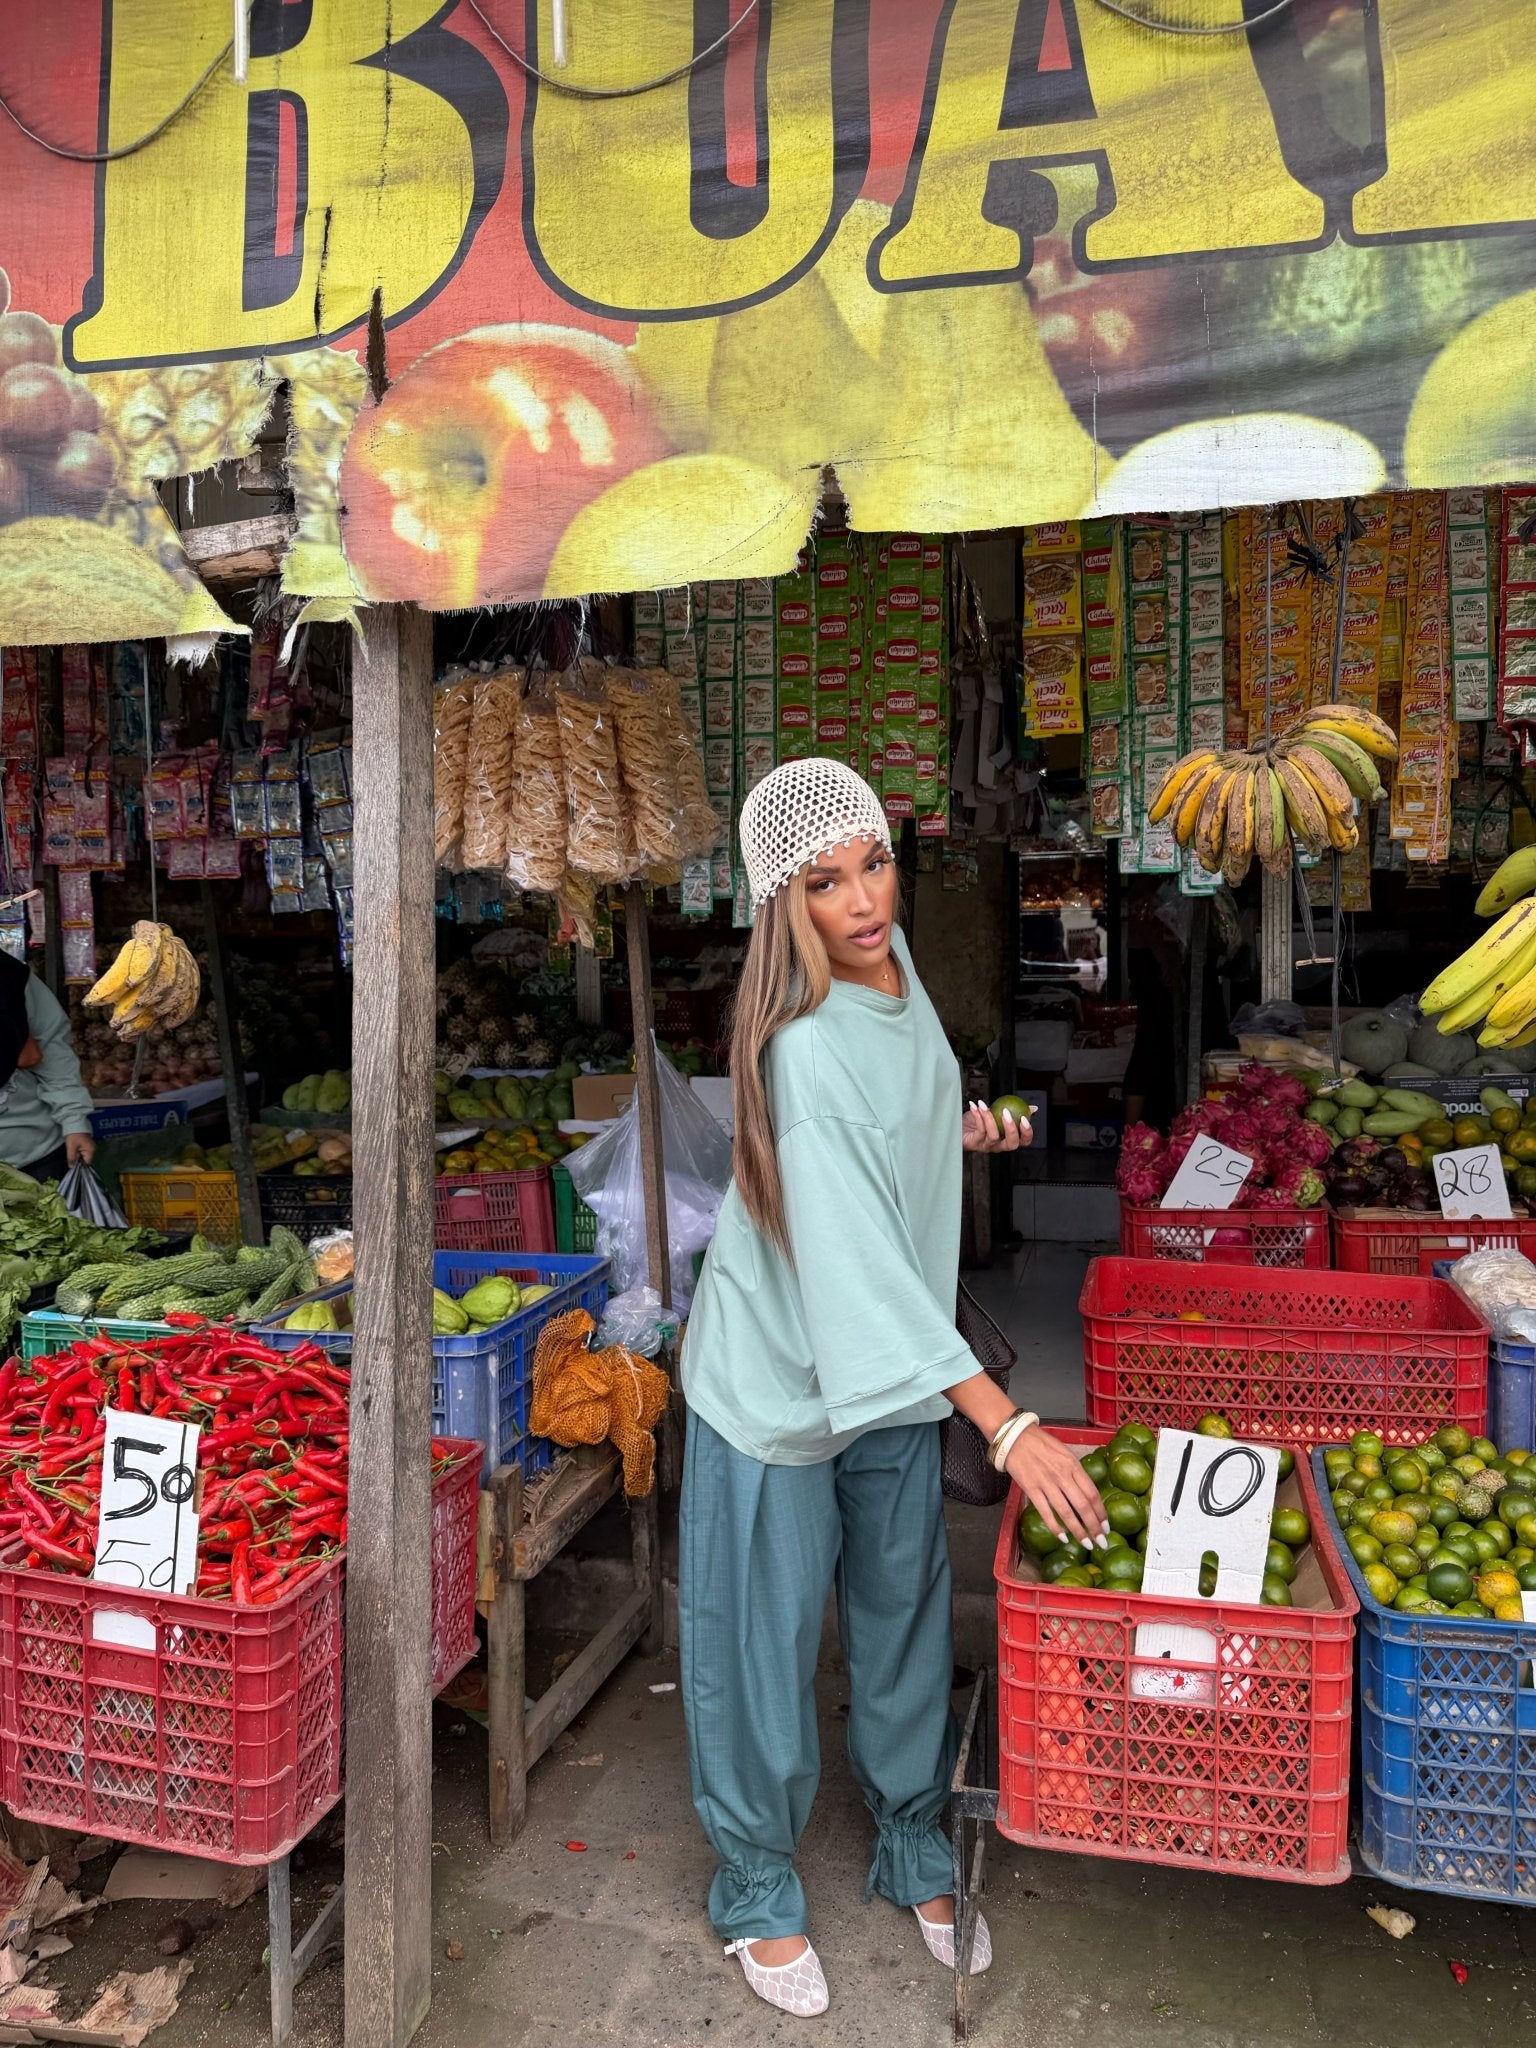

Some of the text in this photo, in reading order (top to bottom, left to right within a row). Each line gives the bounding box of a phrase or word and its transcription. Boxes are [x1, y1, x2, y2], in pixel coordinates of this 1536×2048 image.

[1086, 556, 1112, 569] Ladak
[1347, 563, 1383, 579] Masak
[1033, 601, 1067, 619] Racik
[1344, 612, 1379, 628] Masak
[1340, 662, 1375, 679] Masak
[1032, 682, 1066, 700] Racik
[1403, 747, 1439, 763] Masak
[1194, 1145, 1248, 1187] 25
[1439, 1154, 1492, 1198] 28
[104, 1437, 195, 1522] 50
[1170, 1439, 1266, 1517] 10
